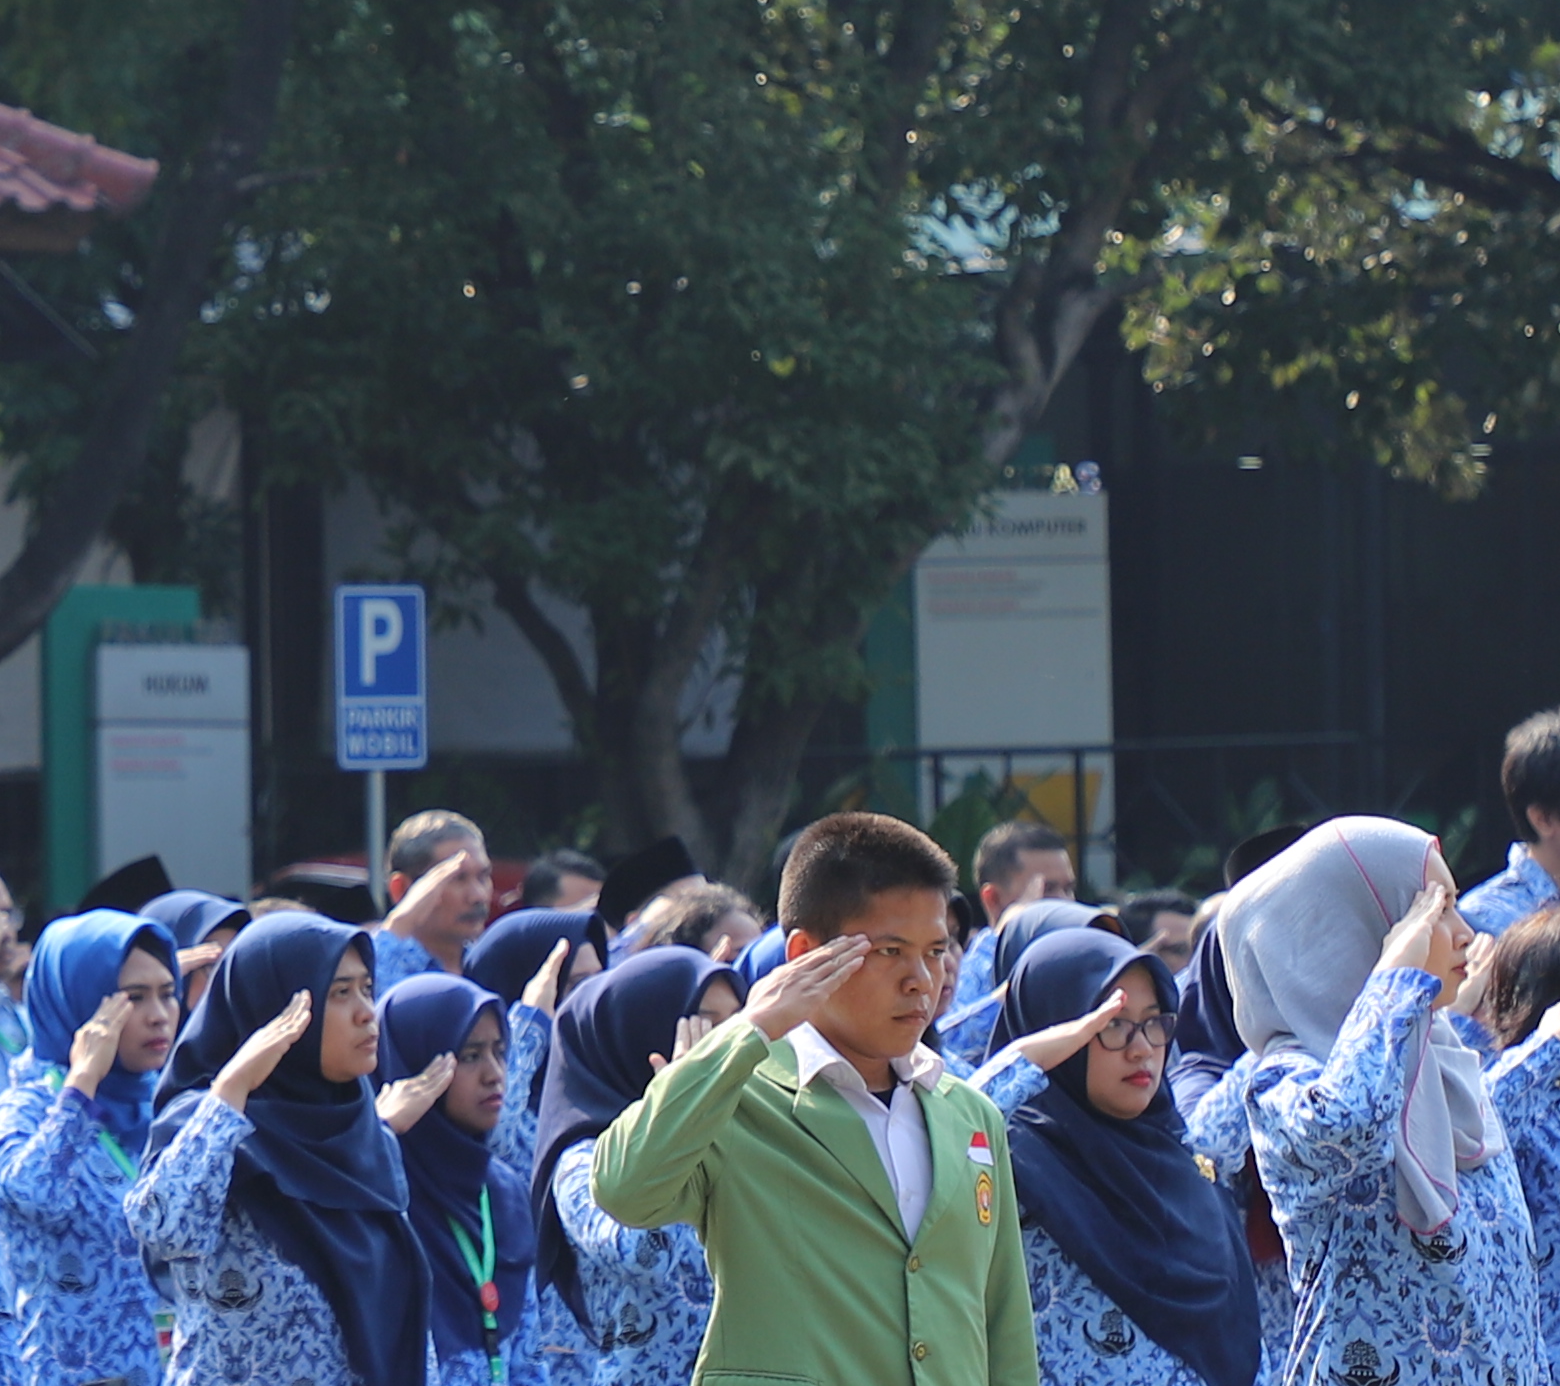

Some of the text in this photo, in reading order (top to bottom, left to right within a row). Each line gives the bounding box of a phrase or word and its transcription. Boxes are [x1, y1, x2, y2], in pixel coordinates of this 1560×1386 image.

[359, 597, 404, 687] P
[347, 707, 417, 729] PARKIR
[348, 732, 416, 758] MOBIL
